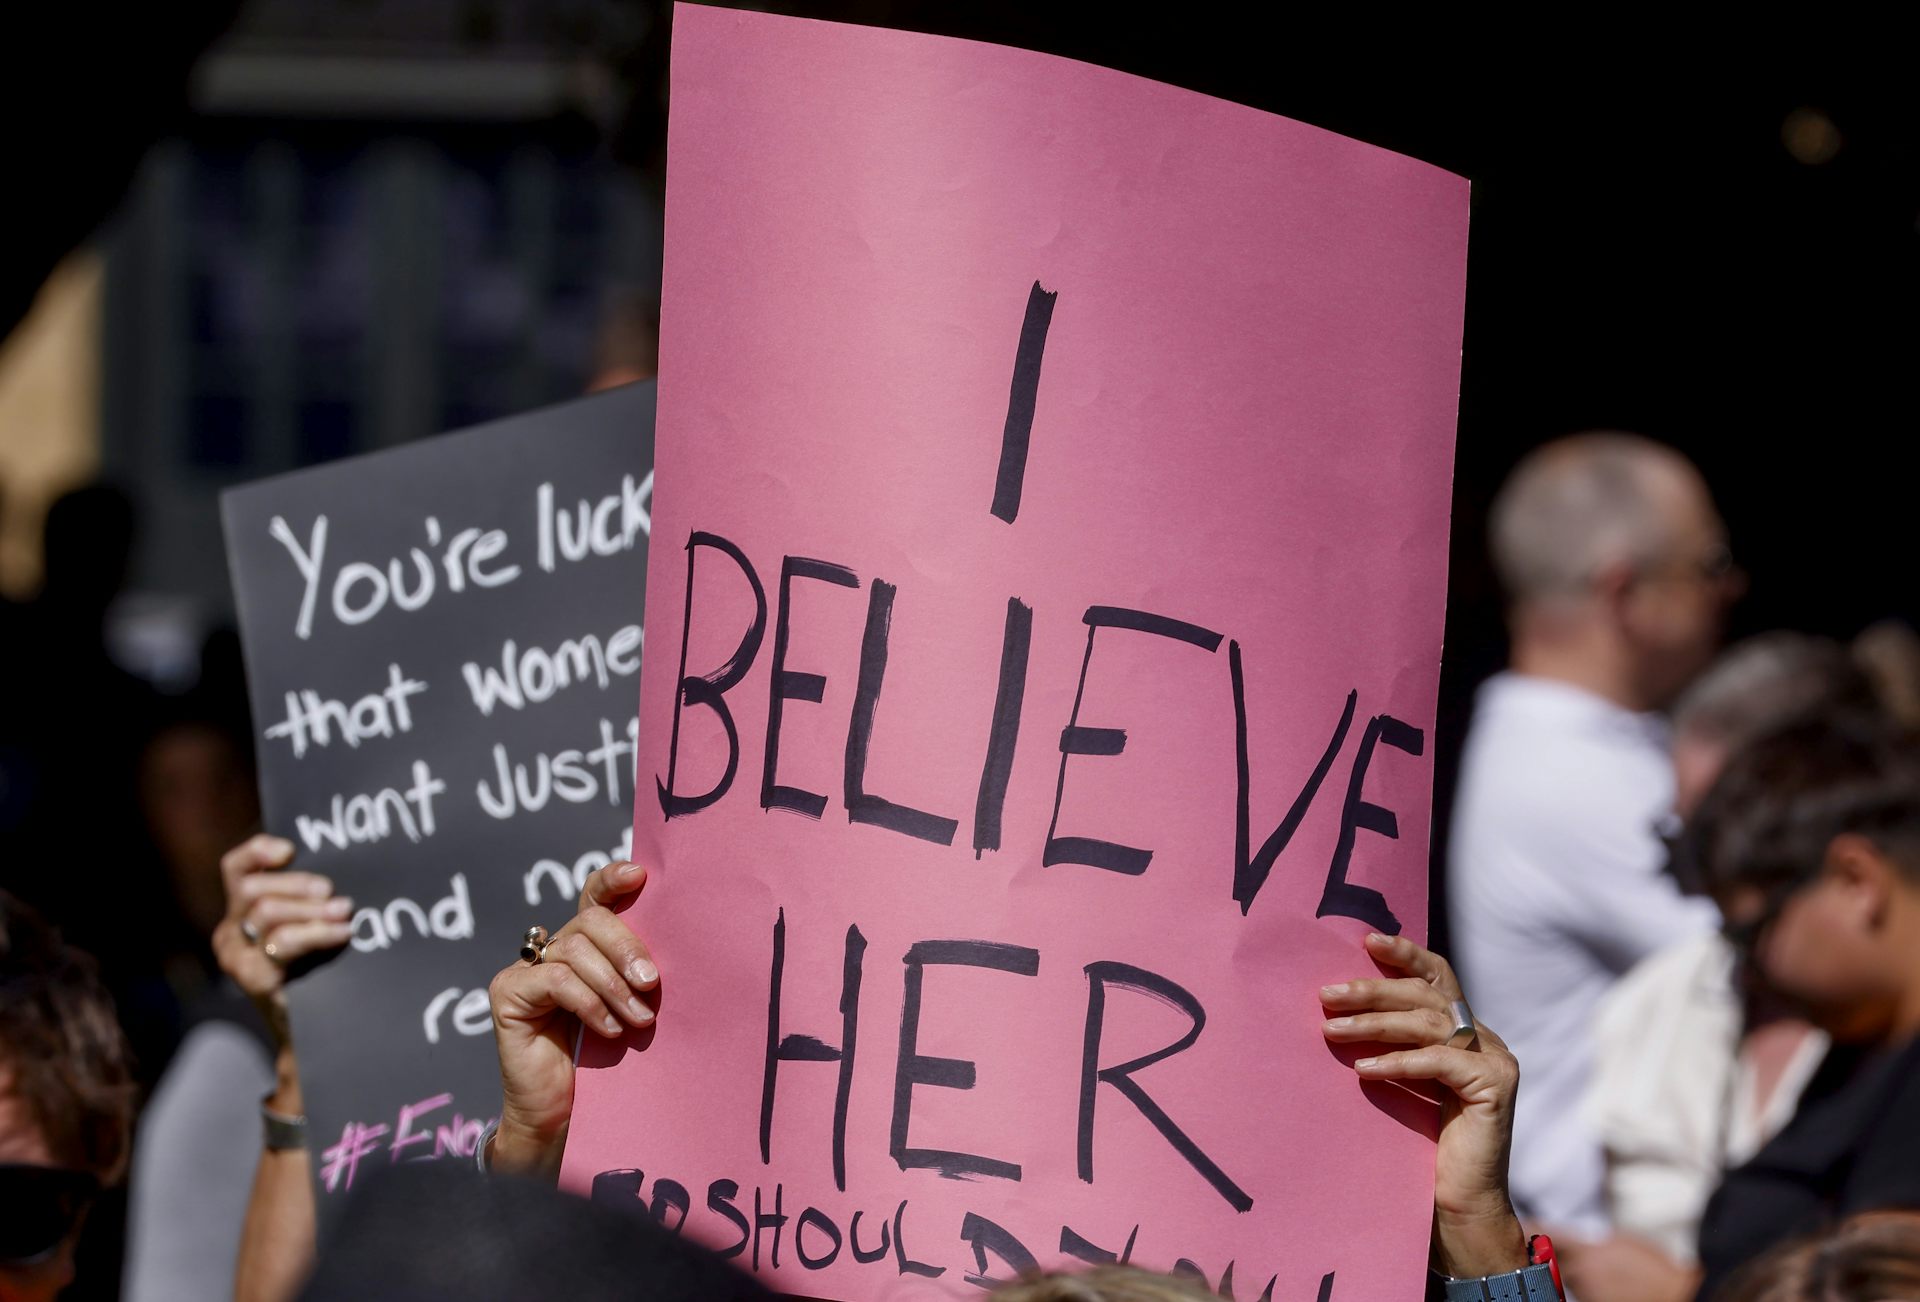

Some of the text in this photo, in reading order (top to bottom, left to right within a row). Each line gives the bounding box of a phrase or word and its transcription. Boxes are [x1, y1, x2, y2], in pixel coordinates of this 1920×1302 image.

[989, 279, 1058, 525] I
[268, 513, 522, 640] You're
[263, 662, 429, 759] that
[655, 529, 1425, 936] BELIEVE
[295, 758, 446, 853] want
[348, 871, 475, 954] and
[758, 906, 1253, 1213] HER
[707, 1177, 1044, 1292] SHOULD
